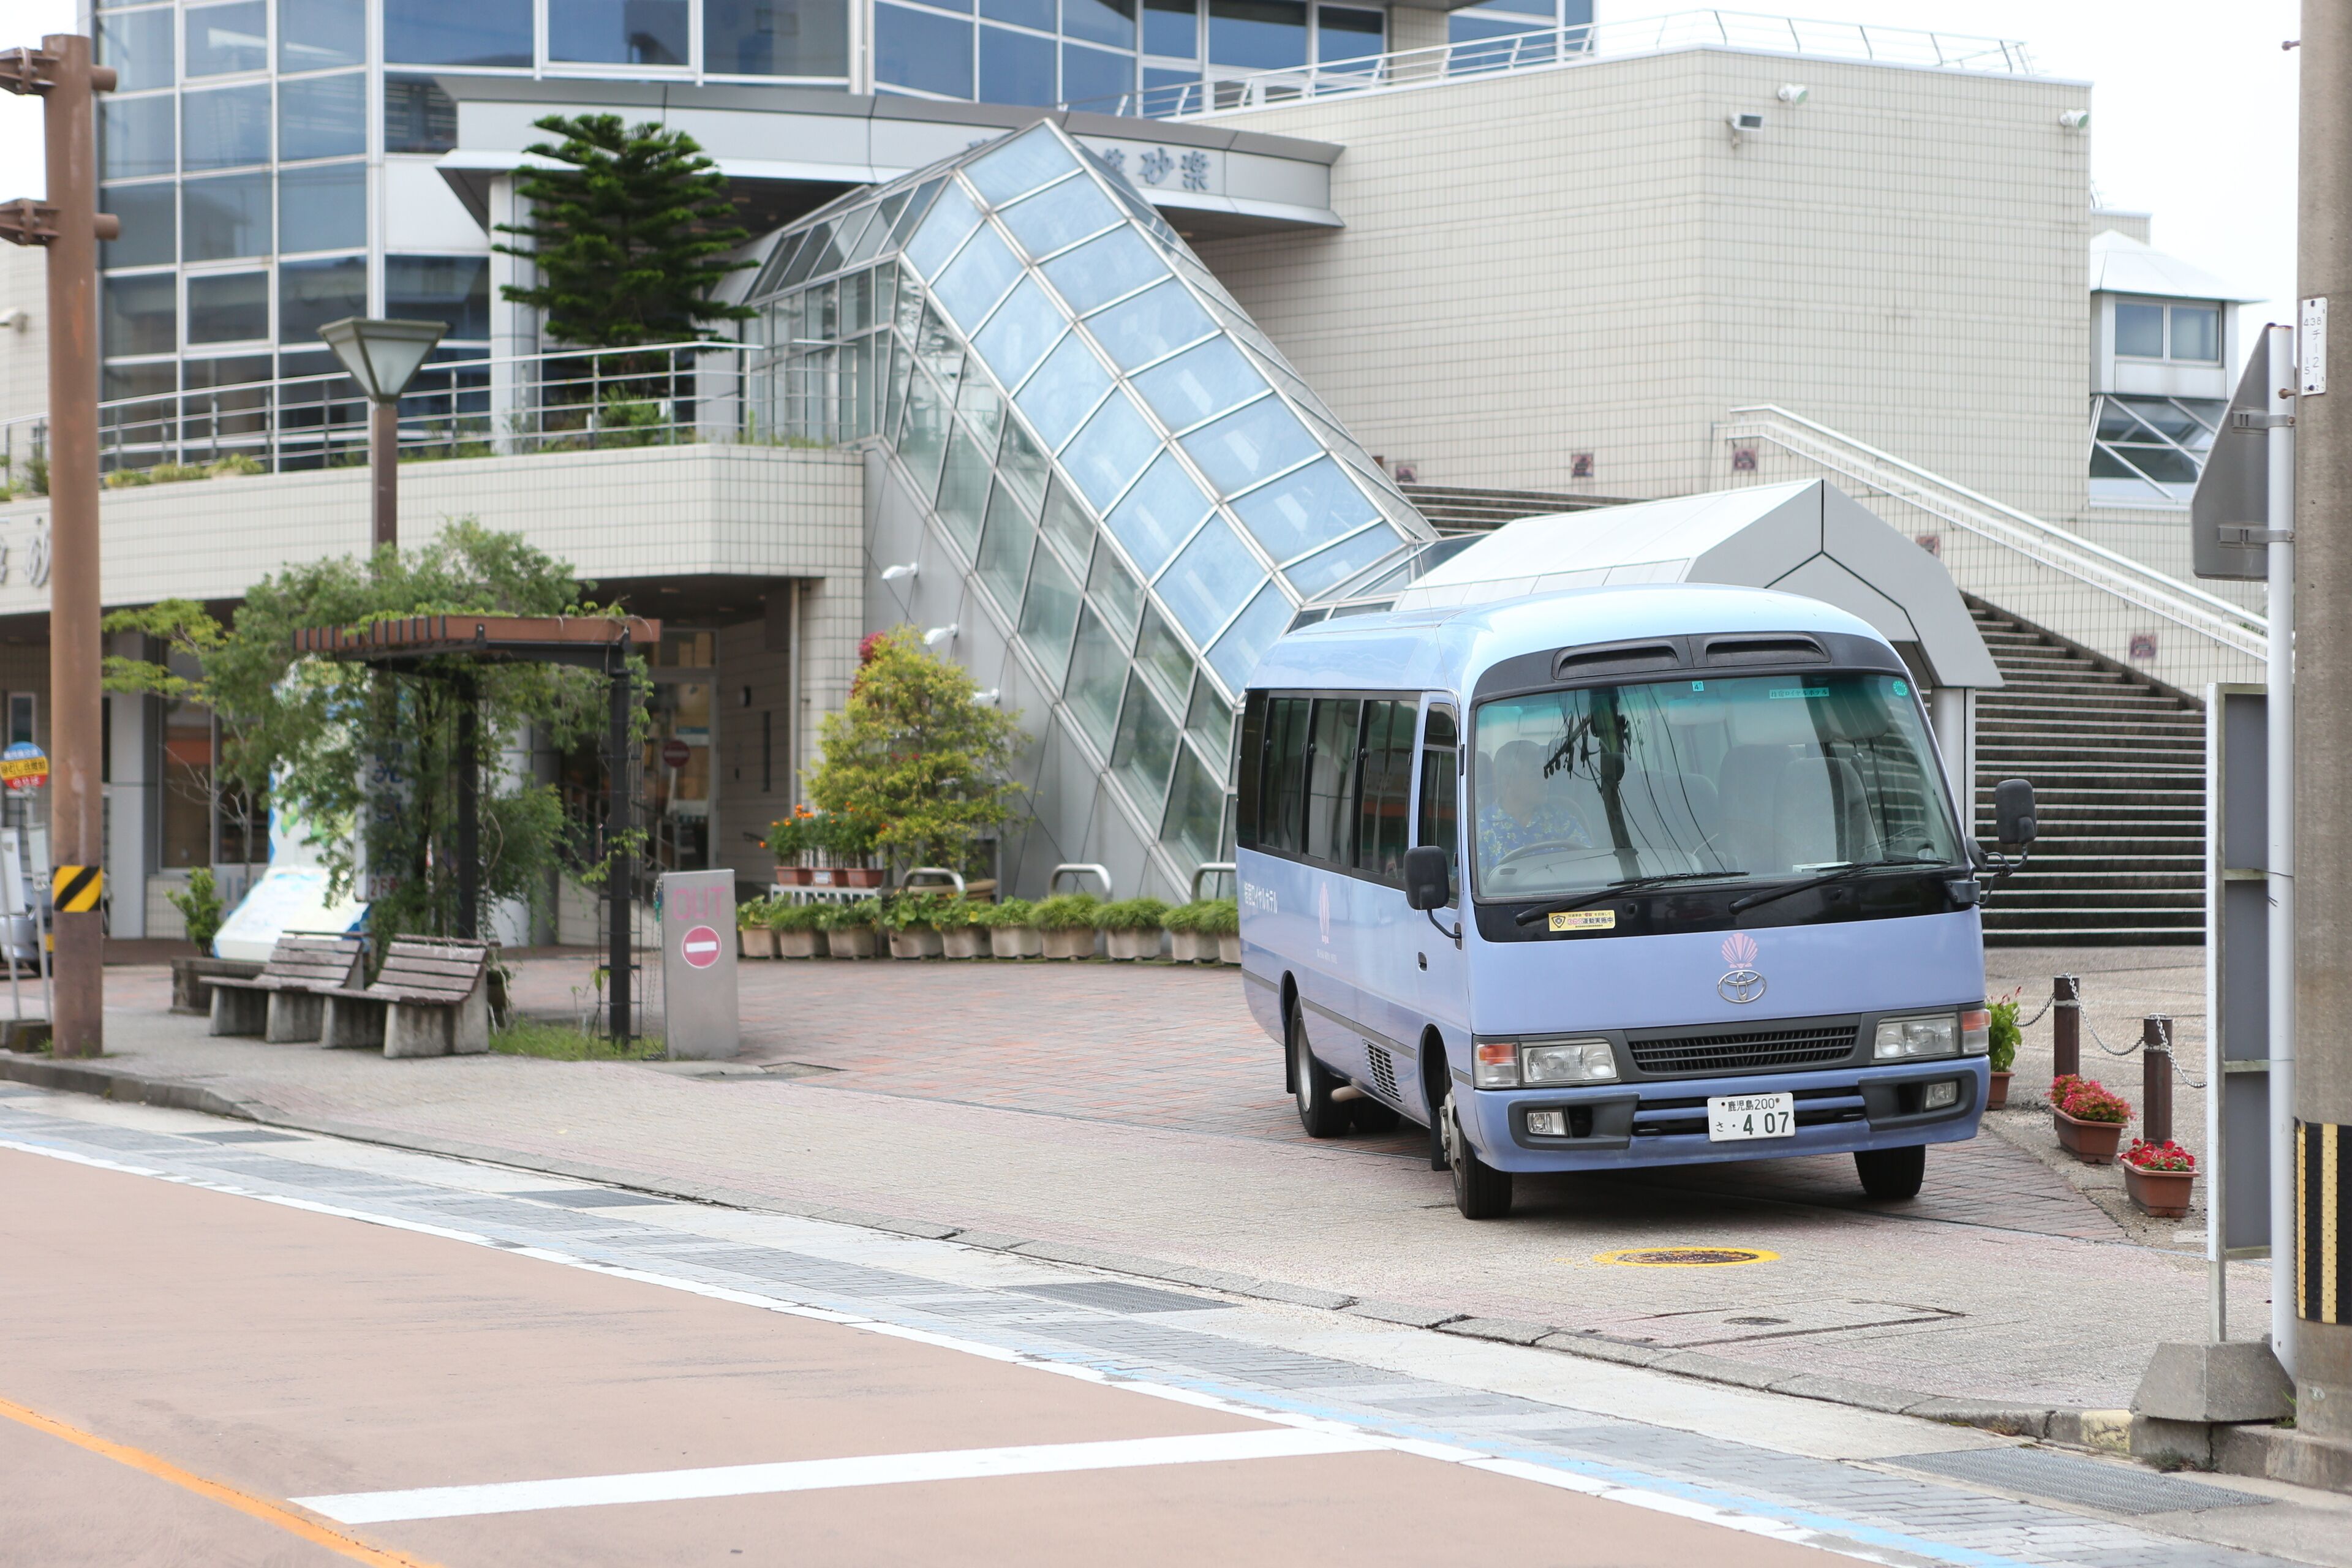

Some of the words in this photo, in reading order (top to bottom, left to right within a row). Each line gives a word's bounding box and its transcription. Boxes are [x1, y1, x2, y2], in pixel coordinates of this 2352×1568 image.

[2304, 317, 2321, 326] 438
[673, 886, 726, 921] OUT
[1716, 1121, 1724, 1132] さ
